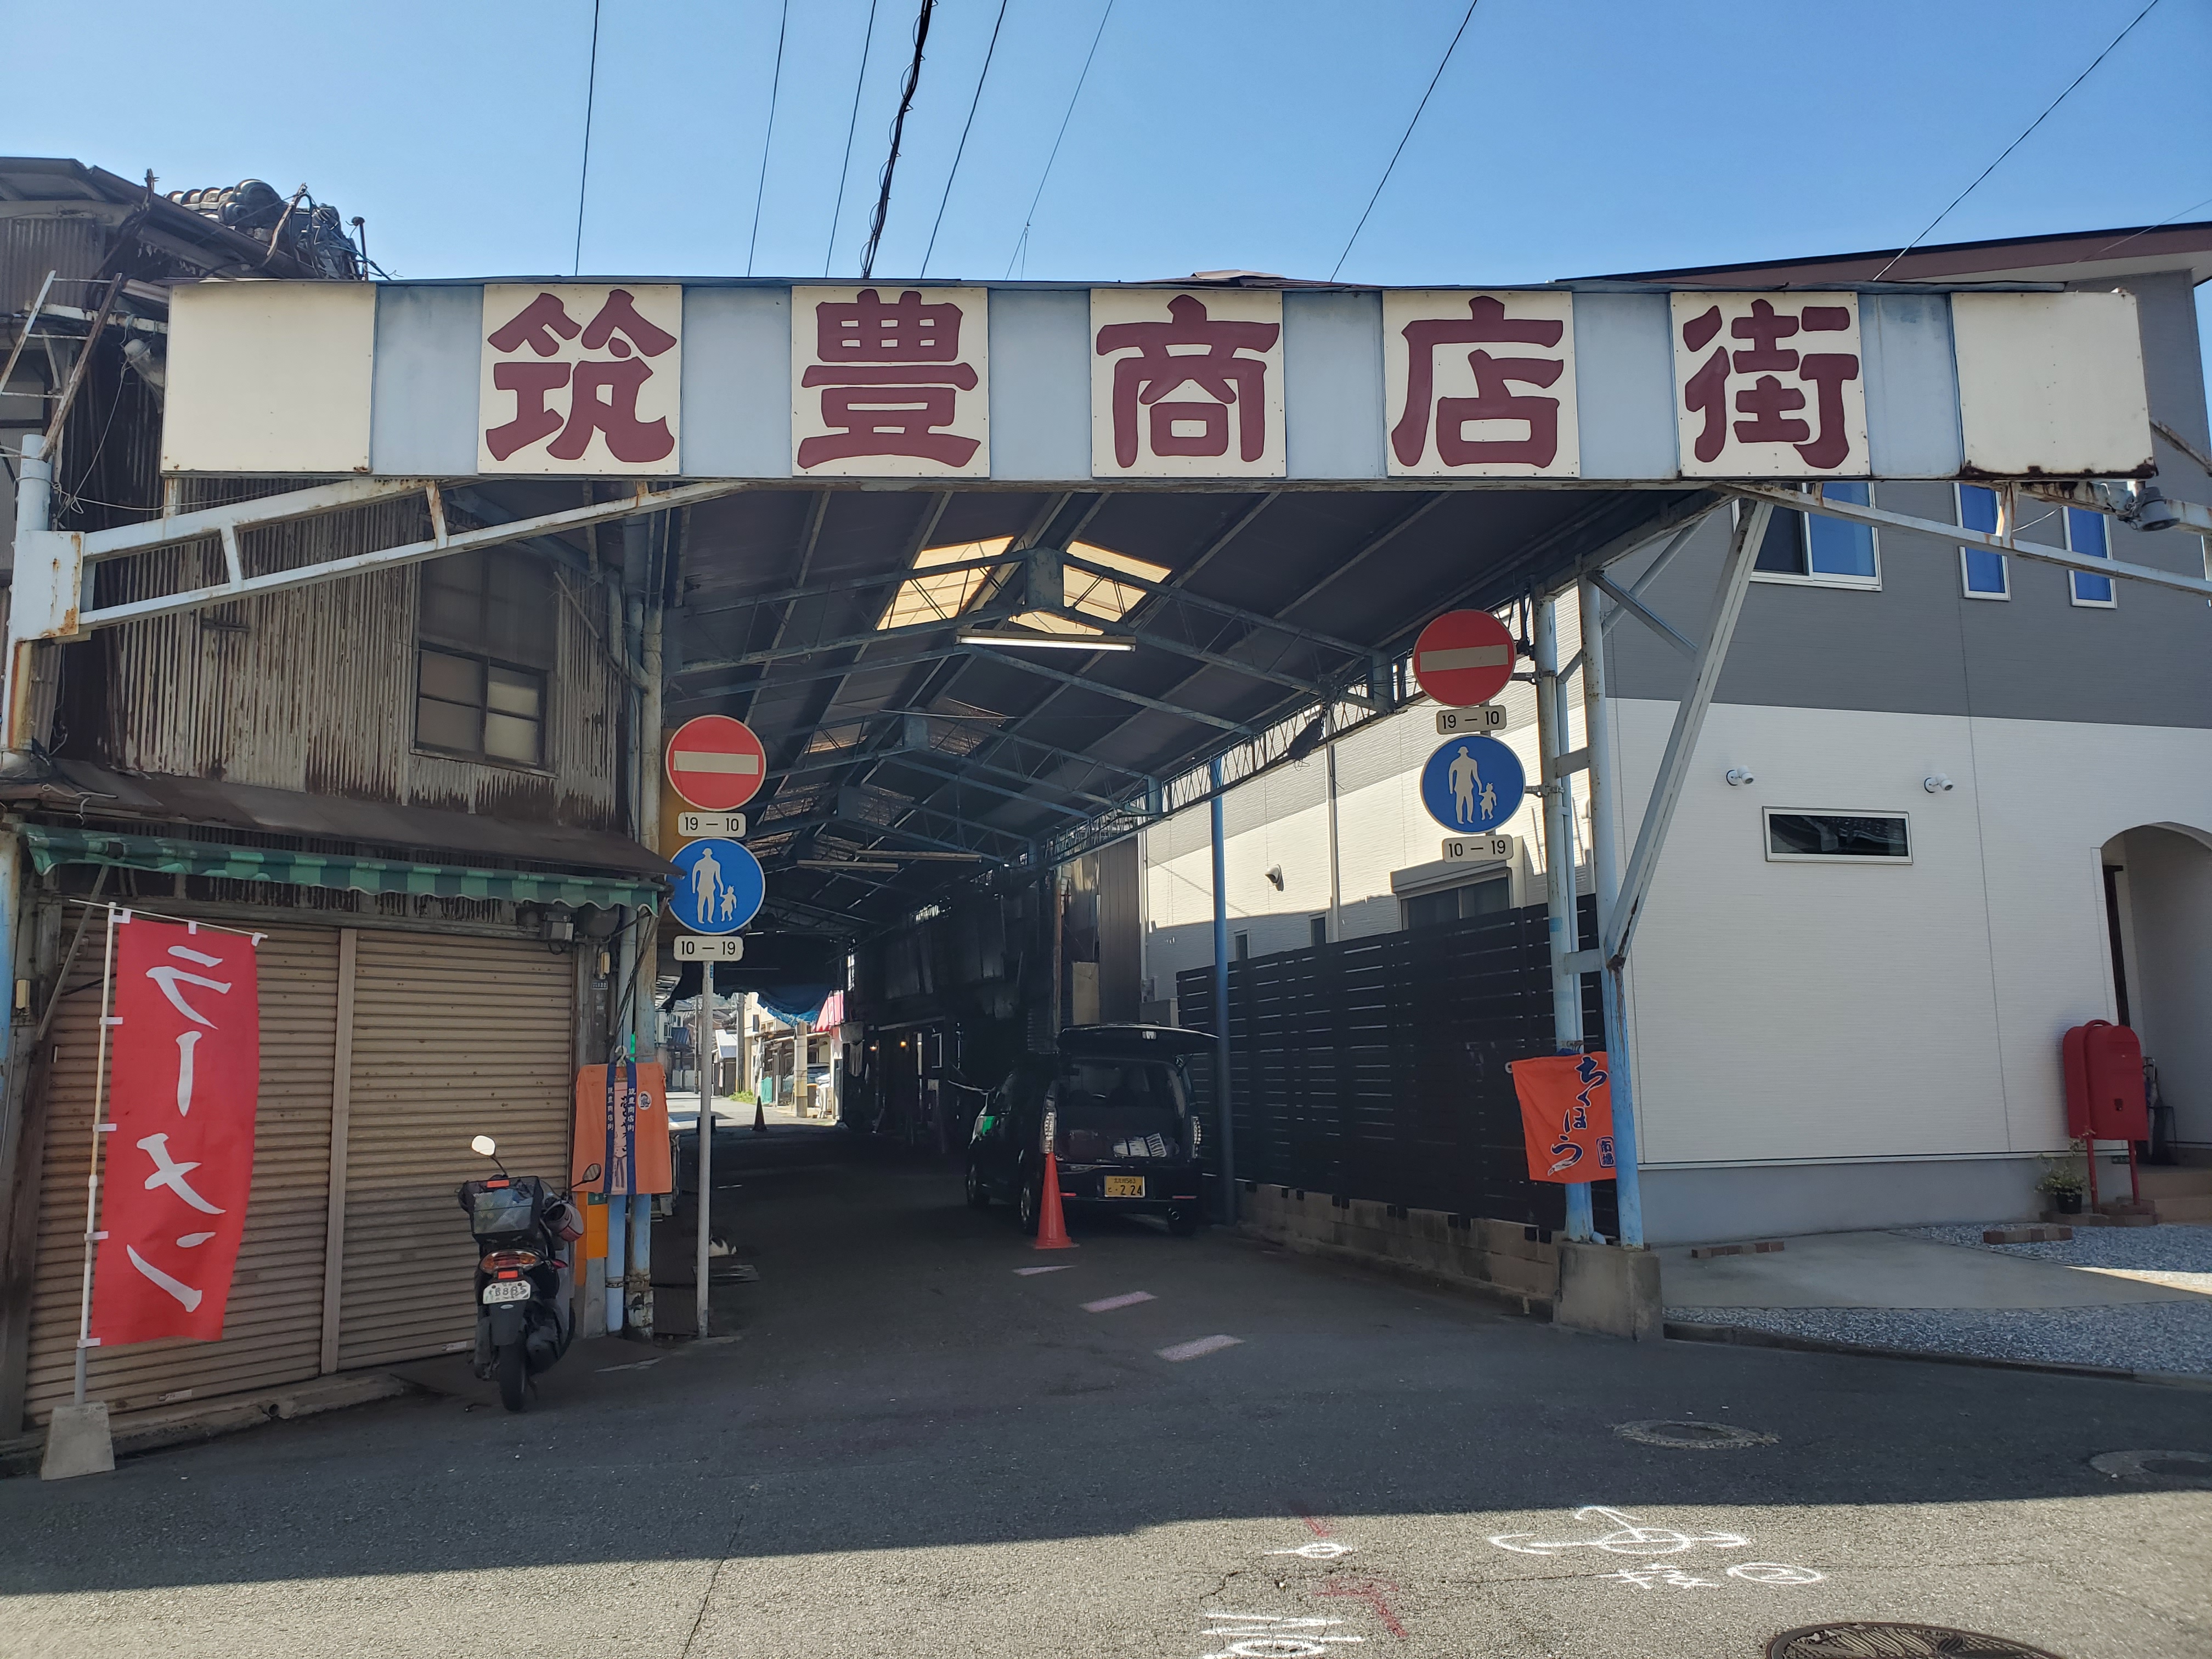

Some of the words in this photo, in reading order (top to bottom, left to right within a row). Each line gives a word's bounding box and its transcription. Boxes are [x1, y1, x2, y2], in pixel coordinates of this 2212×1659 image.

[486, 289, 1859, 469] 筑豊商店街
[1442, 714, 1456, 729] 19
[1485, 710, 1499, 725] 10
[685, 816, 698, 831] 19
[726, 817, 739, 832] 10
[1448, 843, 1463, 857] 10
[1491, 839, 1506, 855] 19
[681, 941, 695, 955] 10
[722, 941, 736, 955] 19
[1547, 1056, 1608, 1176] ちくほう
